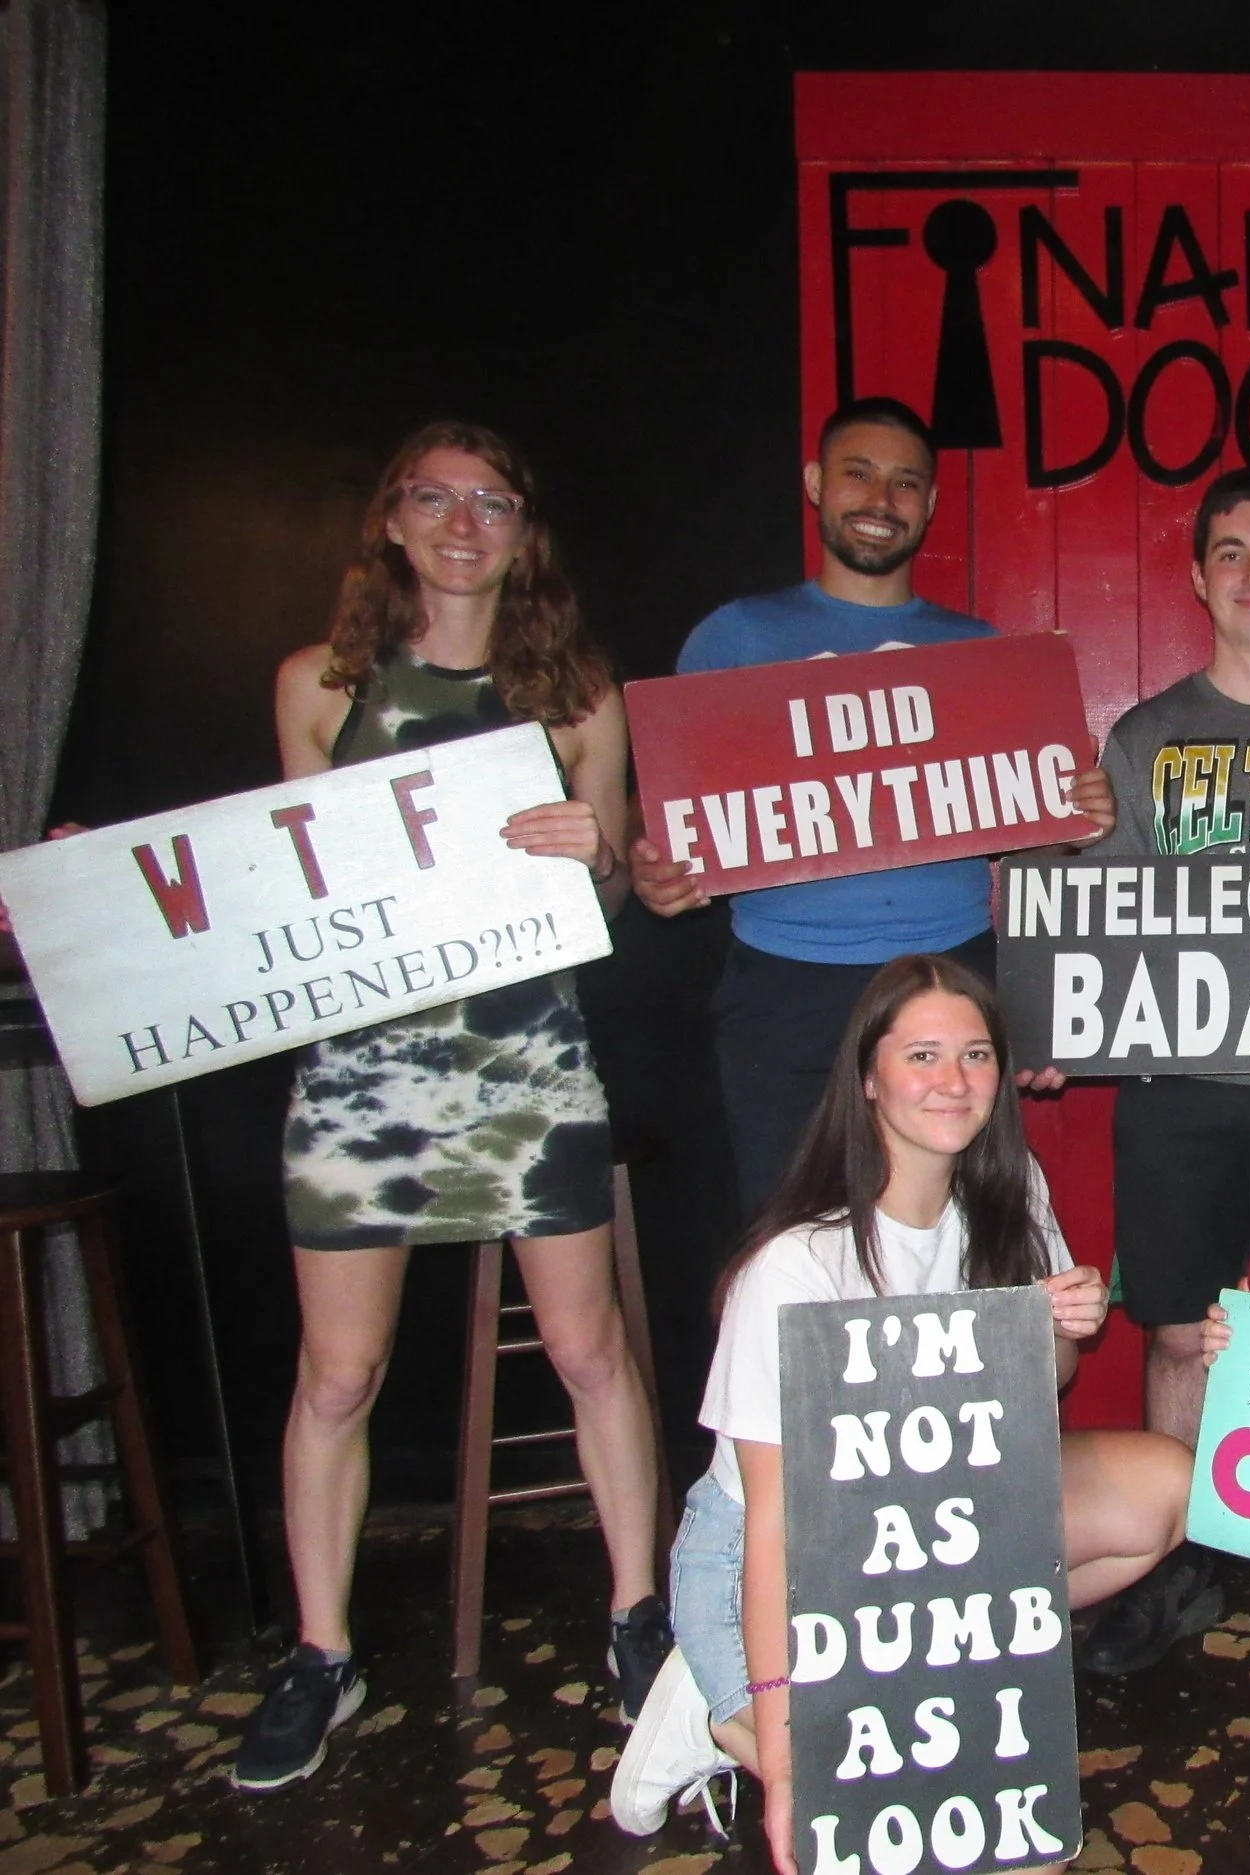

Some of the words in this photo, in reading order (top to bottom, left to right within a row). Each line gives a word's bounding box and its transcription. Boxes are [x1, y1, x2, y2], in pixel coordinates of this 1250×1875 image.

[788, 698, 813, 757] I
[825, 685, 935, 753] DID
[662, 743, 1083, 875] EVERYTHING
[251, 895, 400, 974] JUST
[117, 912, 564, 1074] HAPPENED?!?!
[843, 1310, 984, 1383] I'M
[830, 1400, 1004, 1481] NOT
[862, 1498, 981, 1574] AS
[790, 1587, 1063, 1684] DUMB
[836, 1697, 960, 1780] AS
[994, 1688, 1030, 1758] I
[810, 1784, 1064, 1875] LOOK
